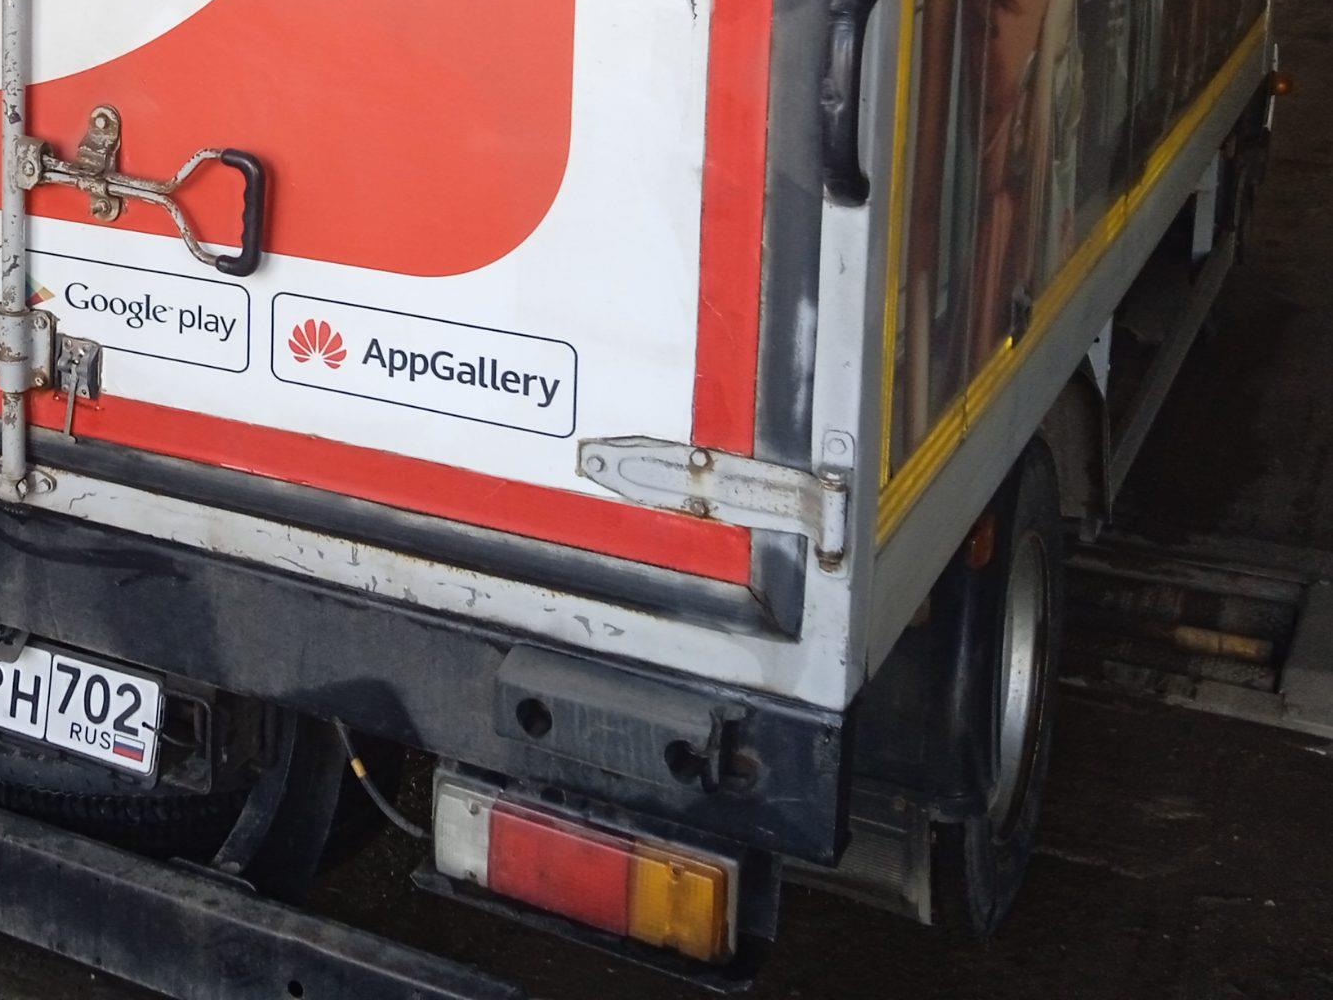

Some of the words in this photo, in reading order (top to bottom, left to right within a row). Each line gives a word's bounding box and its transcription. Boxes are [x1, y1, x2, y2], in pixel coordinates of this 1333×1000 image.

[64, 282, 168, 329] Google
[178, 304, 237, 342] play
[361, 337, 561, 408] AppGallery
[55, 662, 143, 737] 702
[69, 721, 112, 750] RUS
